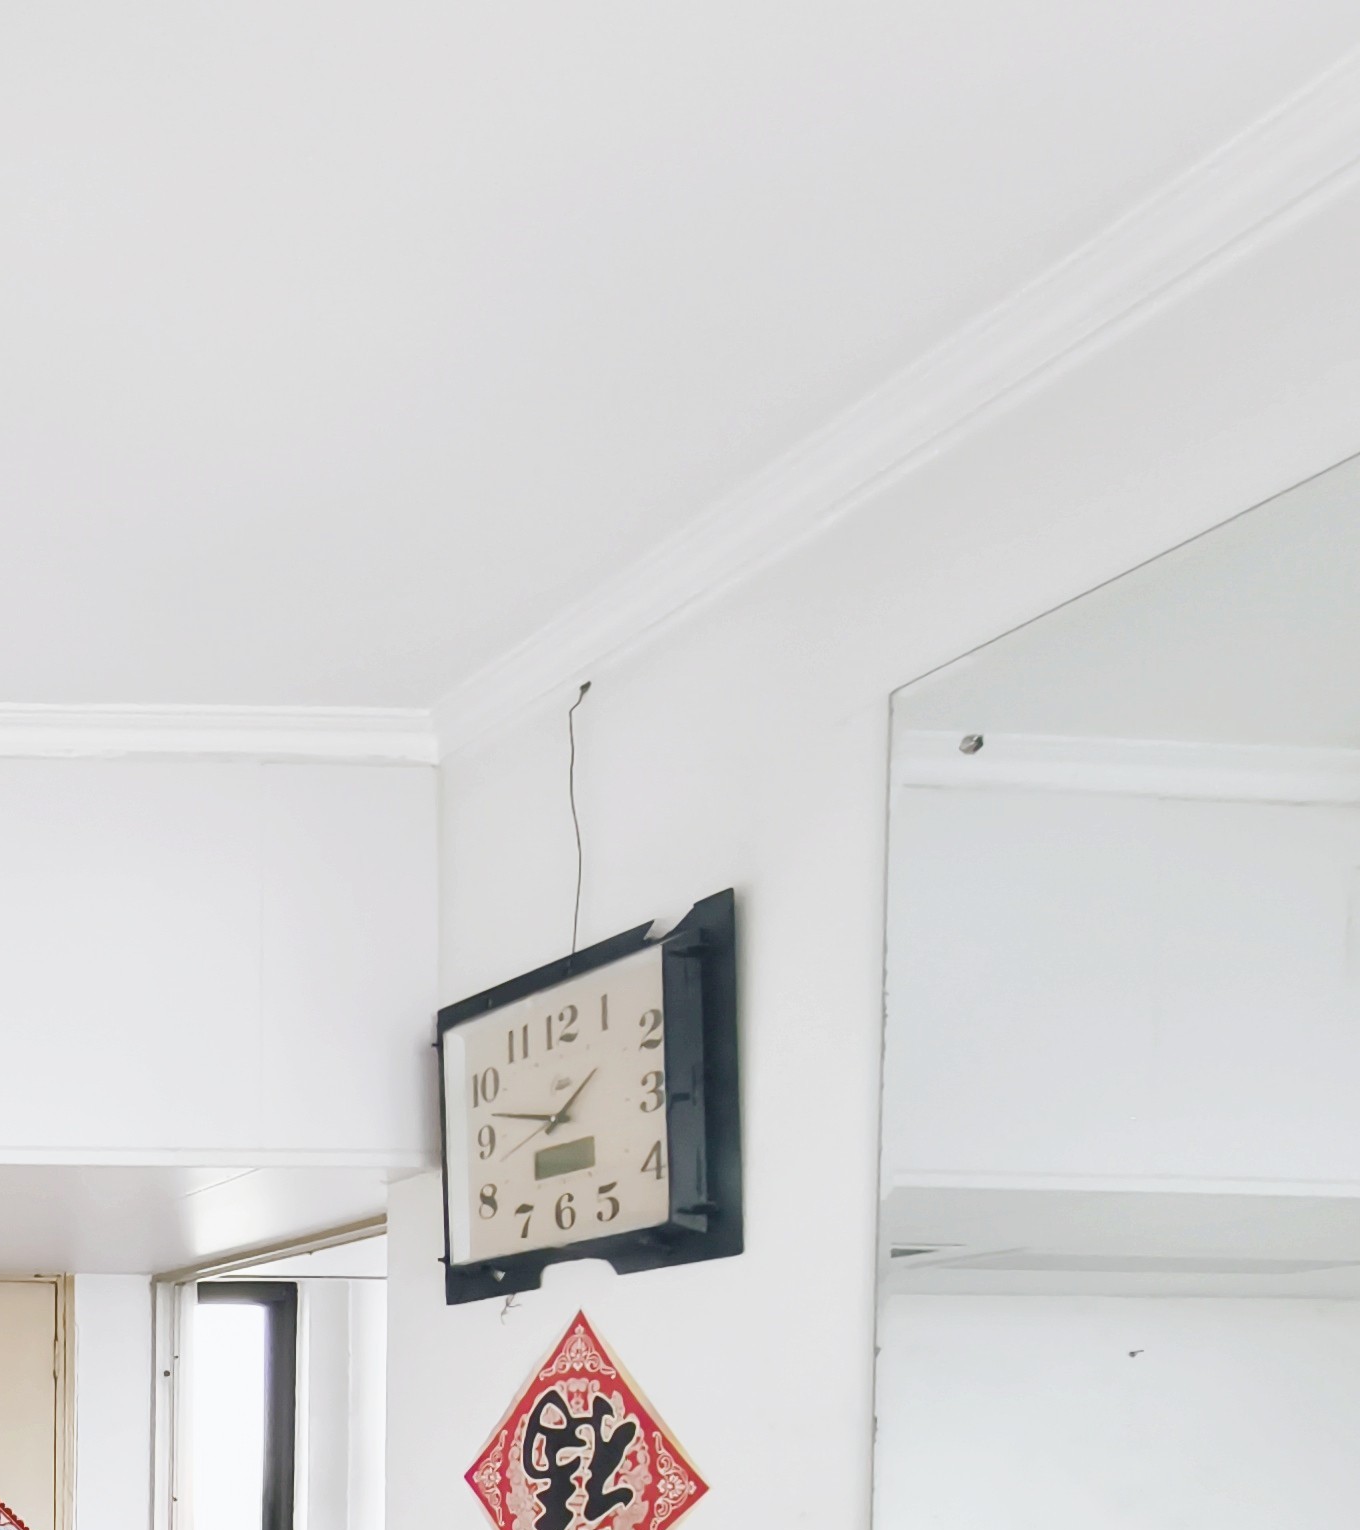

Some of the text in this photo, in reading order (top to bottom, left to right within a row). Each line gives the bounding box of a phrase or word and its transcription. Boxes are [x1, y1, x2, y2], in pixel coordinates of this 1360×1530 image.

[545, 1004, 579, 1051] 12
[599, 993, 609, 1031] 1
[639, 1008, 663, 1049] 2
[507, 1023, 529, 1064] 11
[472, 1066, 500, 1108] 10
[640, 1070, 665, 1112] 3
[477, 1124, 497, 1160] 9
[640, 1140, 666, 1180] 4
[478, 1183, 499, 1219] 8
[514, 1203, 534, 1239] 7
[554, 1192, 576, 1230] 6
[596, 1181, 620, 1222] 5
